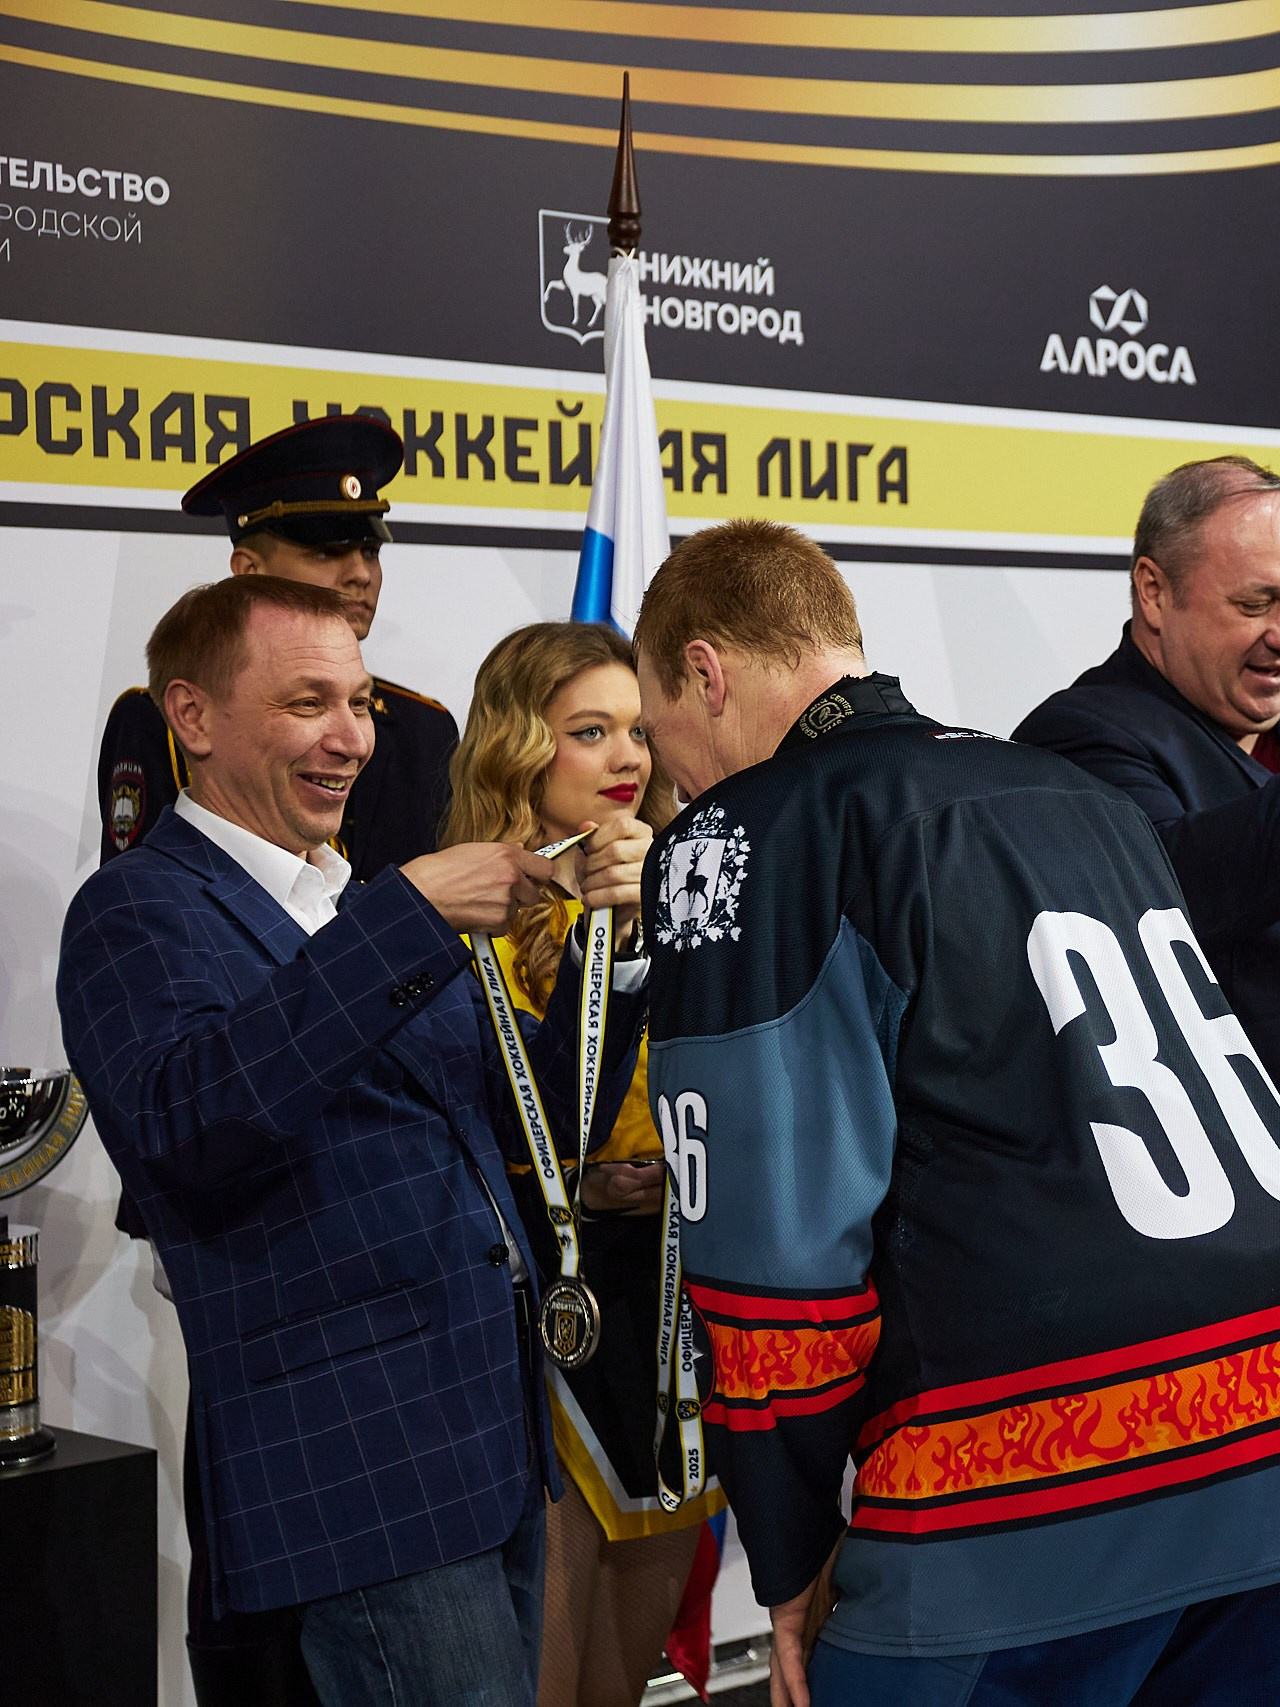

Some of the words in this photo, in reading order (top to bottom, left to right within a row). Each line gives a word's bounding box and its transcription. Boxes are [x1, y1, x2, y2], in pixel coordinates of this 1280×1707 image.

[638, 251, 775, 296] НИЖНИЙ
[641, 294, 804, 346] НОВГОРОД
[1039, 332, 1198, 386] АЛРОСА
[293, 399, 727, 494] ККЕЙАЯ
[757, 437, 908, 505] ЛИГА
[481, 956, 501, 992] ЛИГА
[587, 927, 606, 1029] ОФИЦЕРСКАЯ
[492, 996, 527, 1079] ХОККЕЙНАЯ
[583, 1035, 598, 1125] ХОККЕЙНАЯ
[519, 1084, 555, 1180] ОФИЦЕРСКАЯ
[663, 1243, 677, 1327] ХОККЕЙНАЯ
[660, 1329, 670, 1366] ЛИГА
[687, 1448, 699, 1480] 2025
